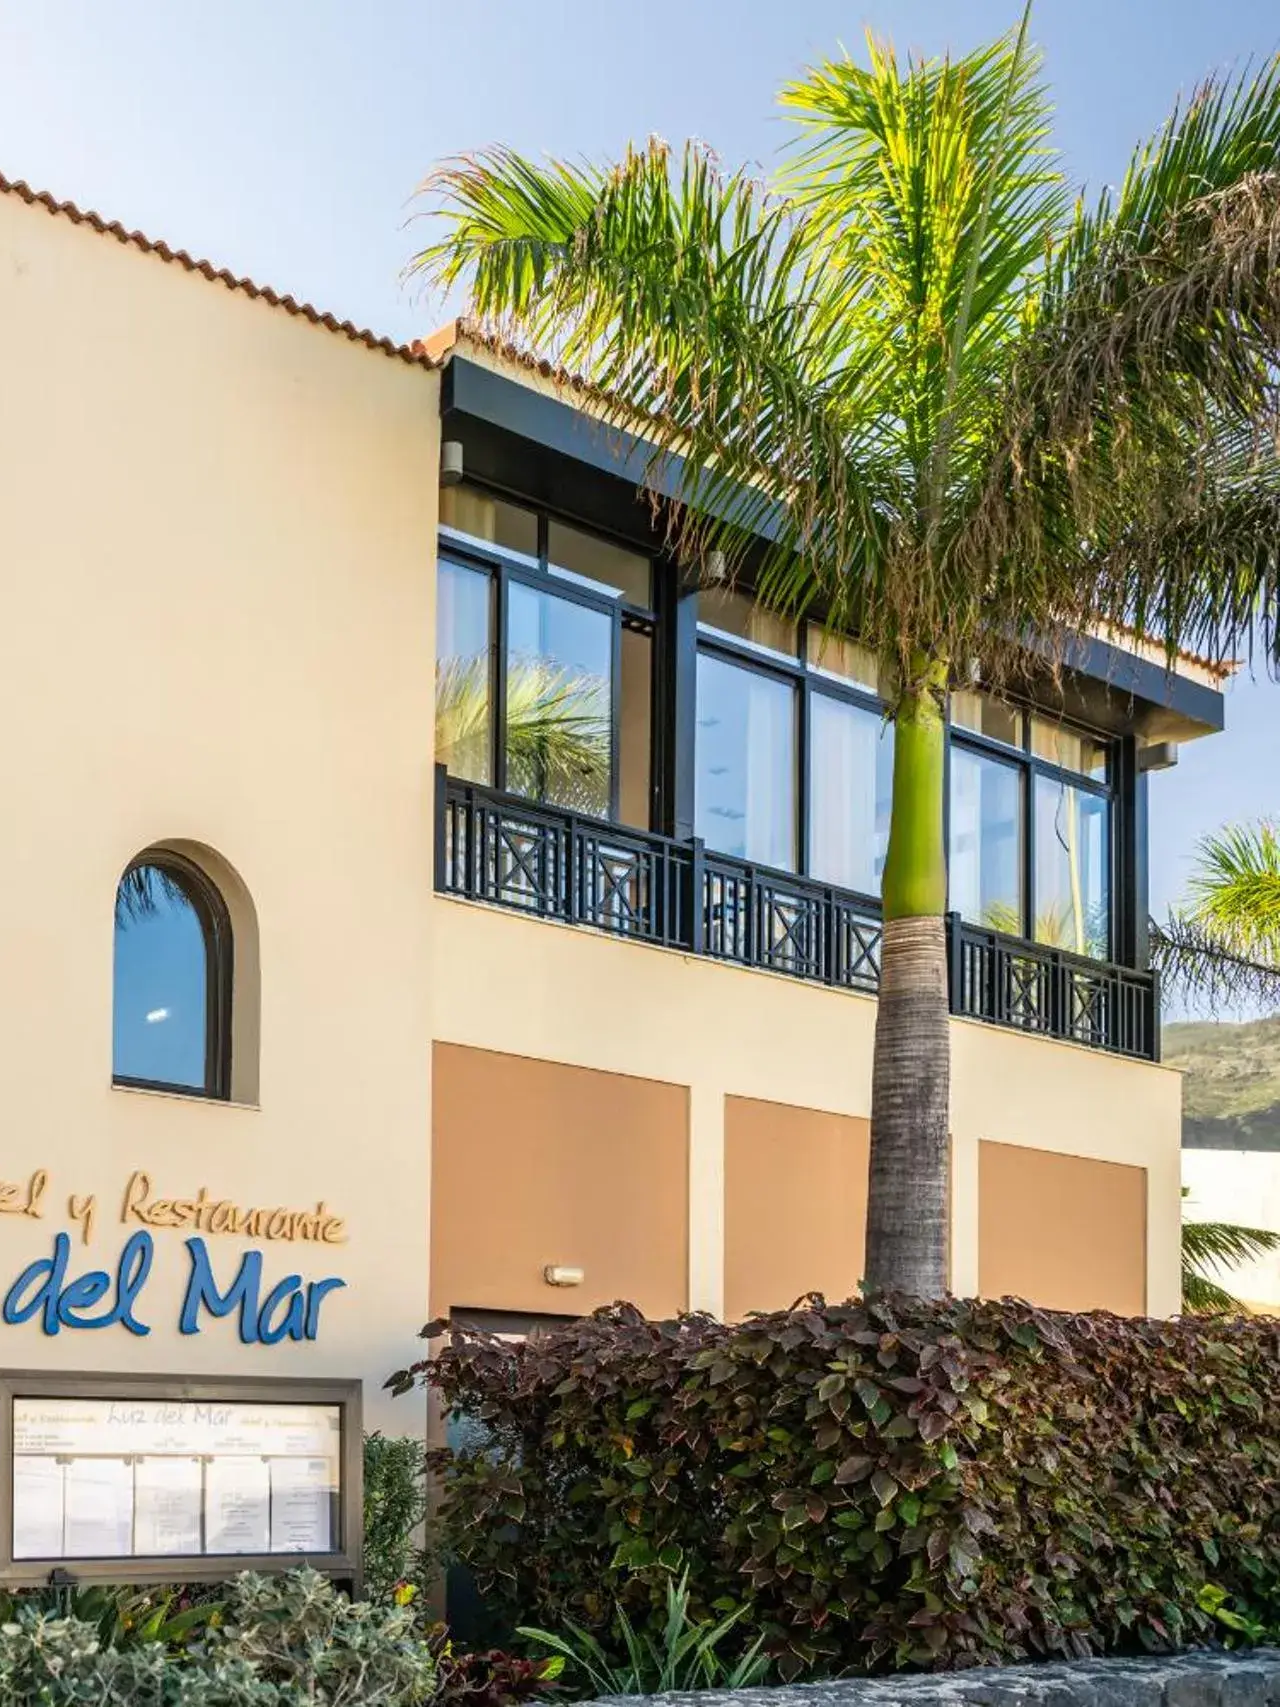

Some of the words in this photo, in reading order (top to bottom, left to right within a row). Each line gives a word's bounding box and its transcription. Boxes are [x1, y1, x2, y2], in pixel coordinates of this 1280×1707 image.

[69, 1194, 96, 1244] y
[119, 1171, 349, 1243] Restaurante
[2, 1230, 154, 1335] del
[178, 1236, 347, 1345] Mar
